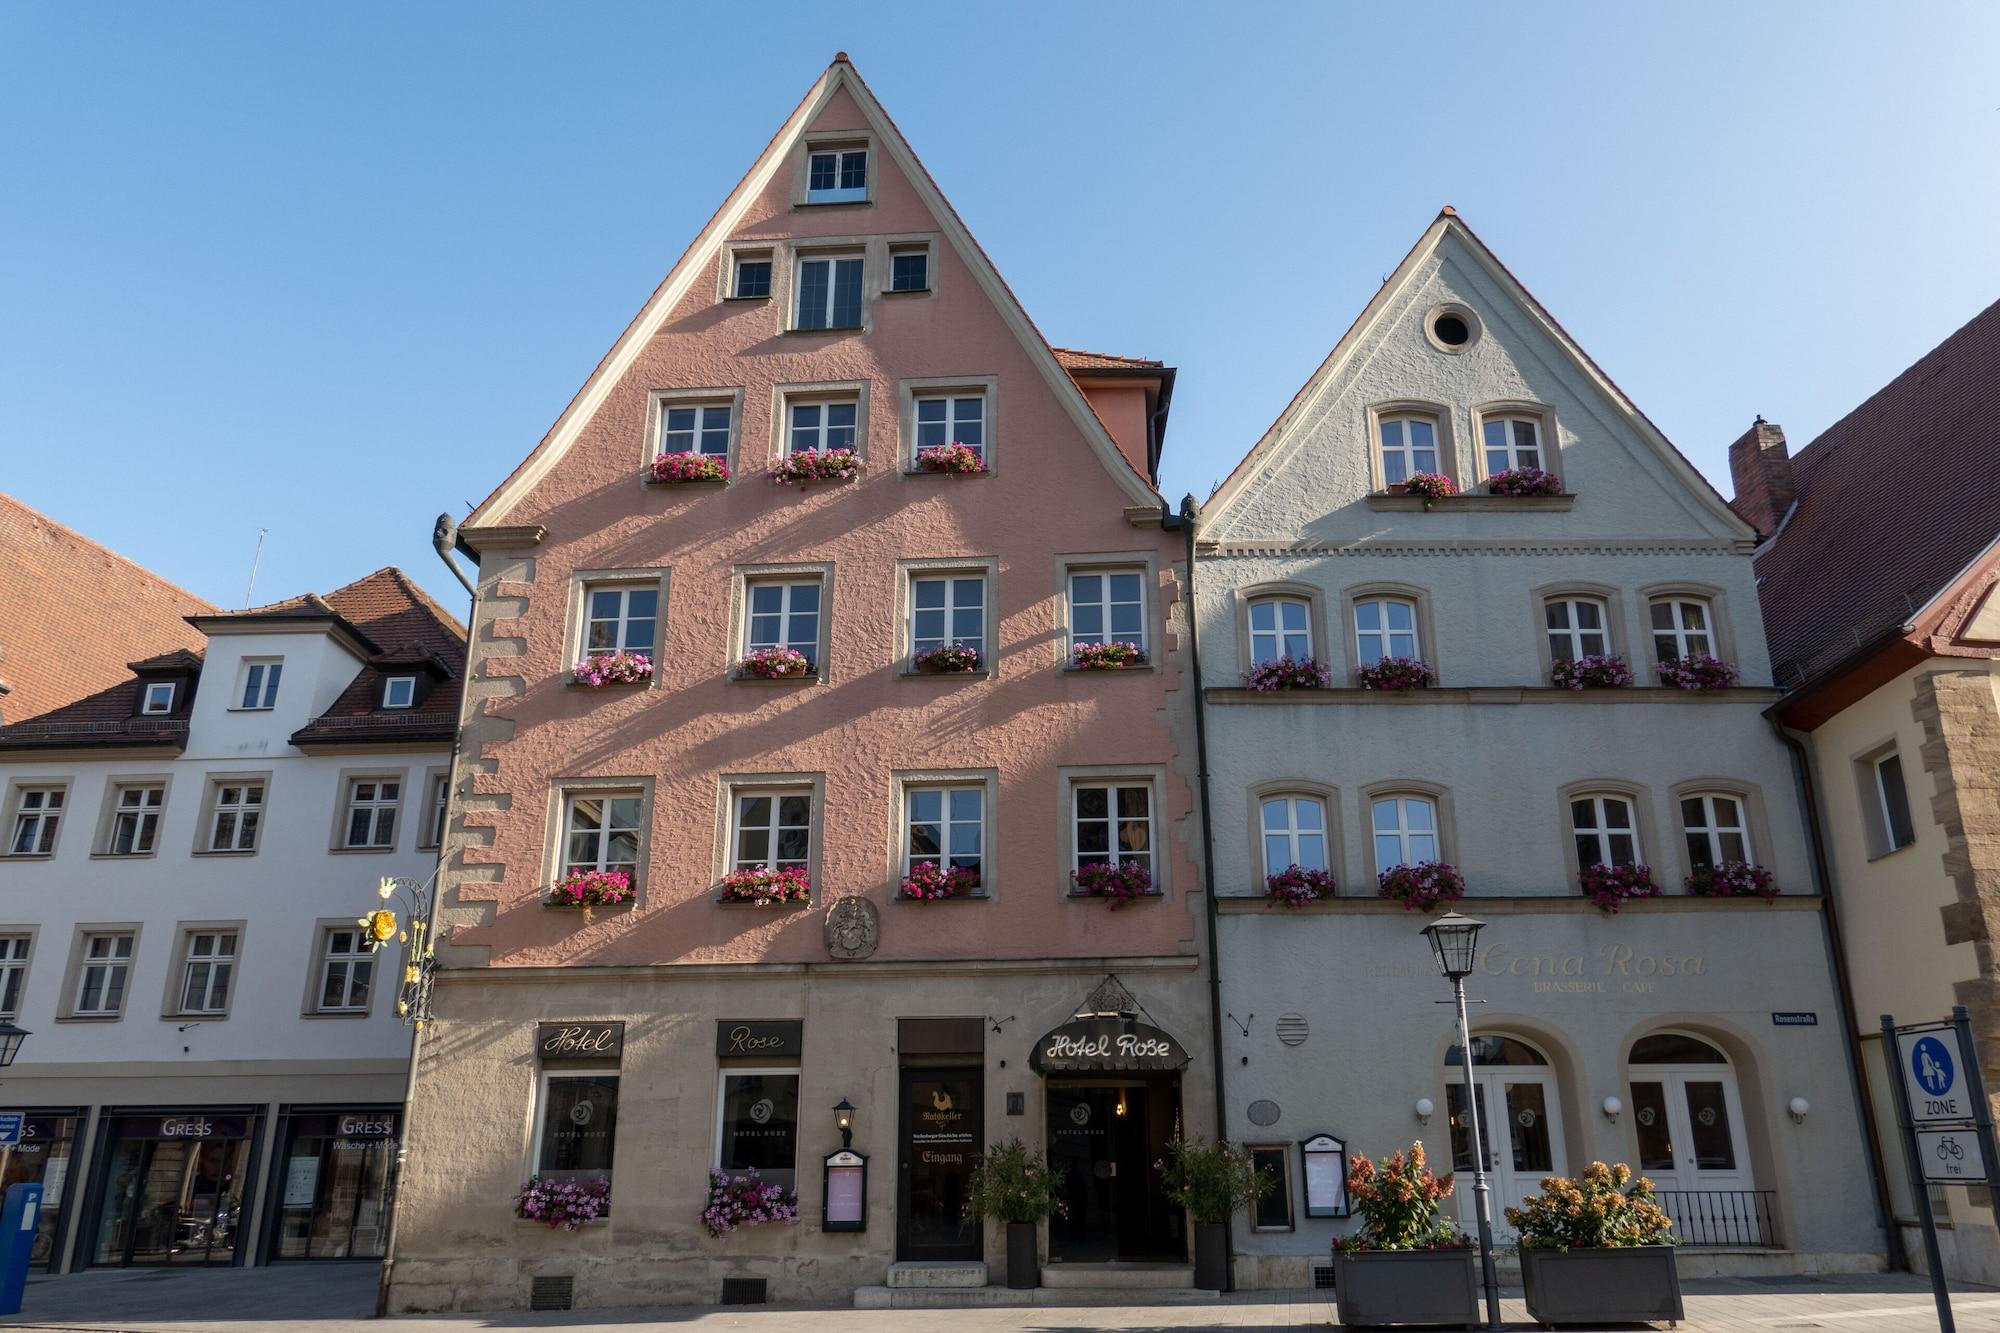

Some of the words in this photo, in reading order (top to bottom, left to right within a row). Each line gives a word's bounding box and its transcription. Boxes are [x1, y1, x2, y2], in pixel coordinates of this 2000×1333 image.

[1480, 942, 1586, 977] Cena
[1600, 942, 1709, 977] Rosa
[544, 1026, 614, 1055] Hotel
[729, 1025, 785, 1052] Rose
[1046, 1034, 1111, 1057] Hotel
[1116, 1034, 1170, 1057] Rose
[1924, 1099, 1958, 1116] ZONE
[922, 1150, 963, 1165] Eingang
[1945, 1163, 1962, 1175] frei
[28, 1192, 38, 1202] P
